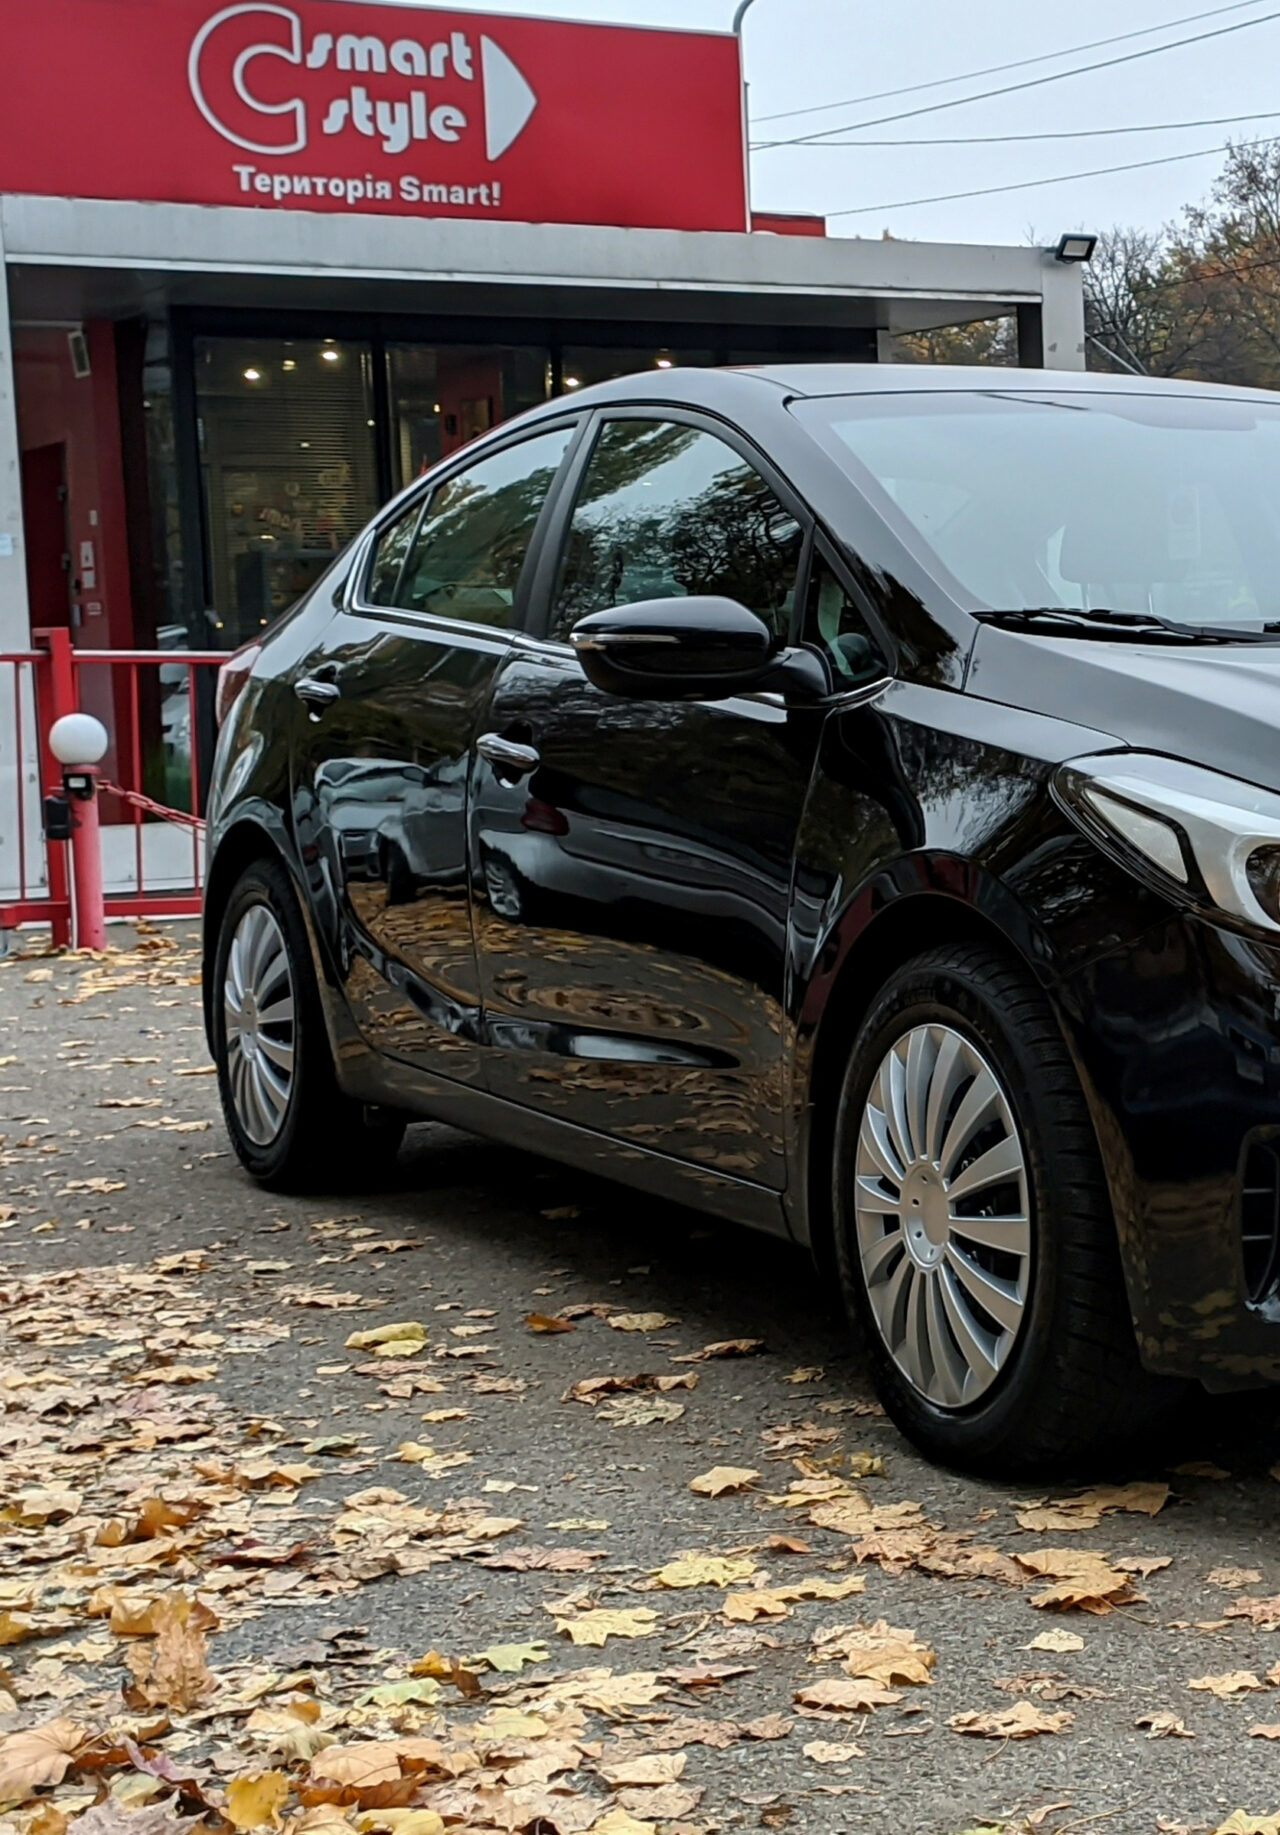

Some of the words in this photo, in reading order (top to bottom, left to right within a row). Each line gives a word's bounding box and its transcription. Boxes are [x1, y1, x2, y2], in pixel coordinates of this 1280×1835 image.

[306, 32, 474, 80] smart
[322, 86, 467, 154] style
[232, 165, 392, 204] Територія
[399, 176, 501, 206] Smart!
